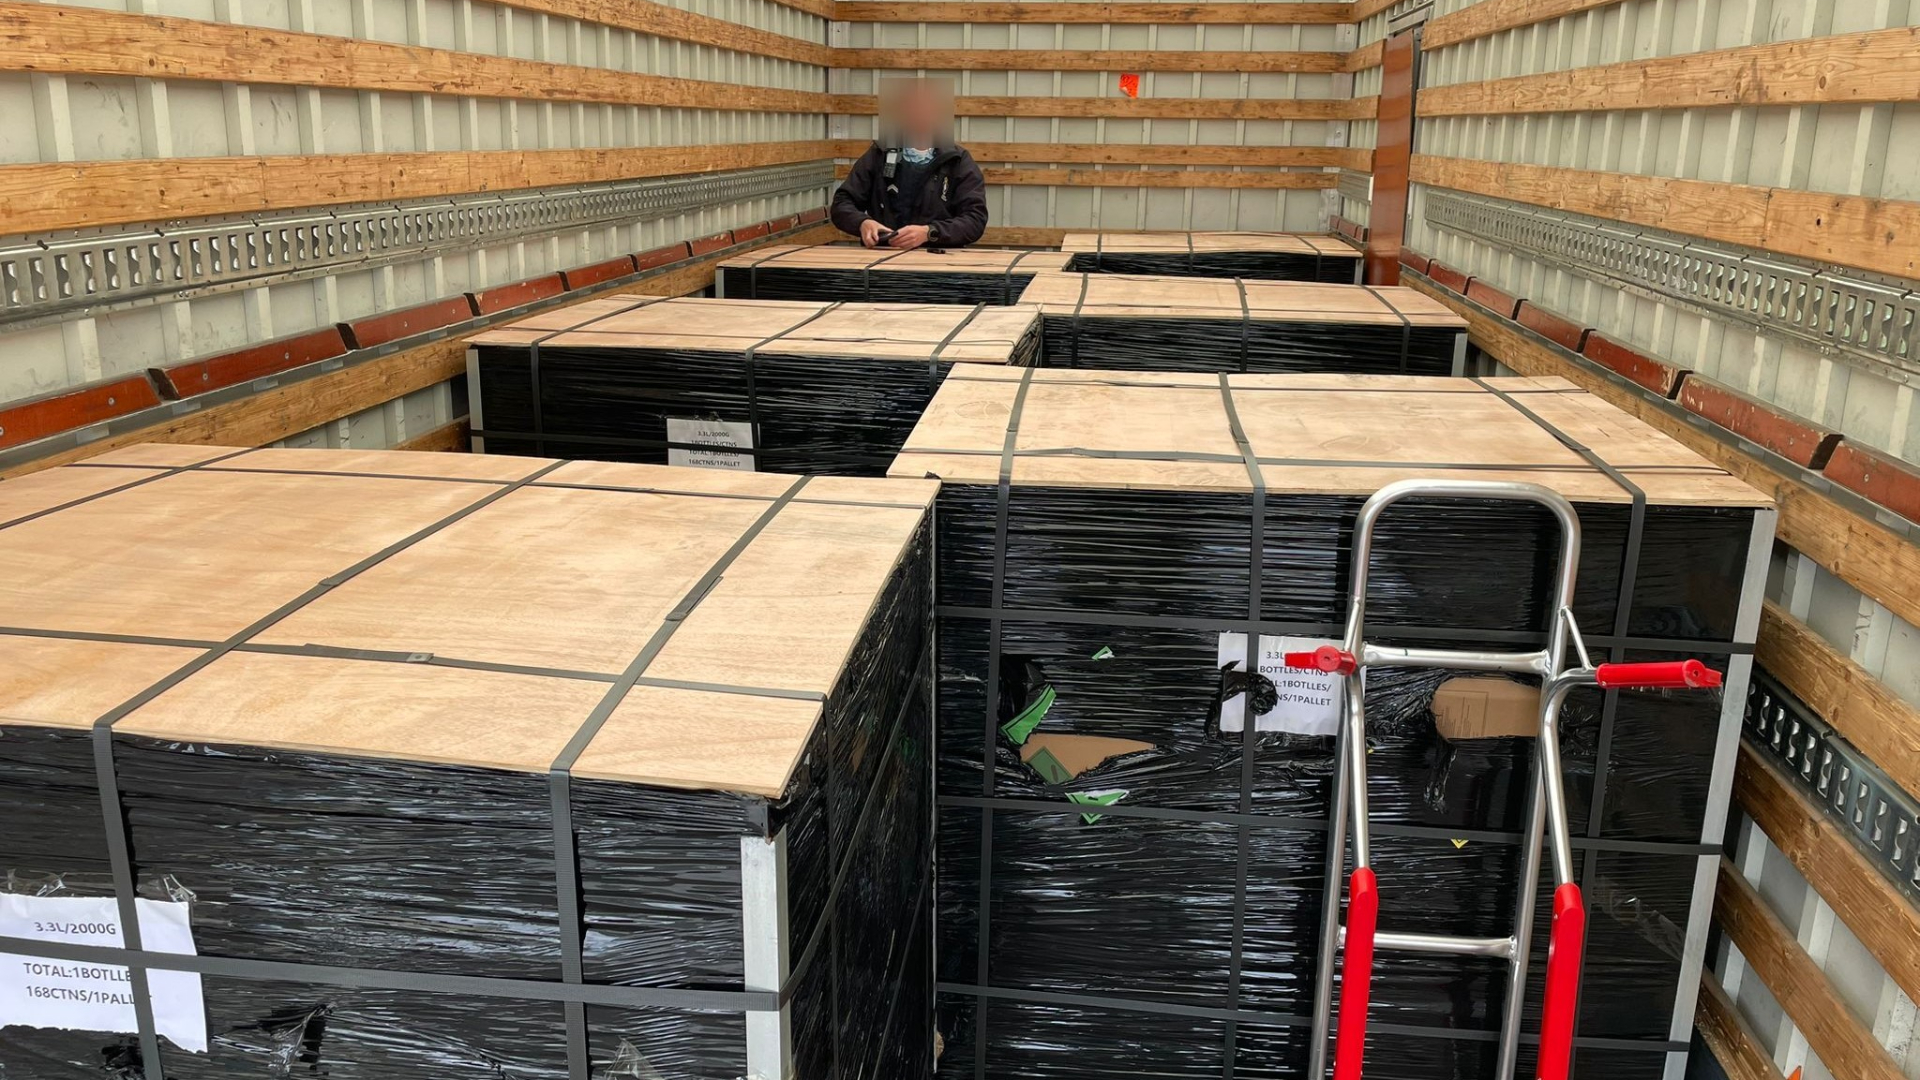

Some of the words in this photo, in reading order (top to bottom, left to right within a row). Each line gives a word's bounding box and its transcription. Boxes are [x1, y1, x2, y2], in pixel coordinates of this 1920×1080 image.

[1274, 680, 1332, 692] L:1BOTLLES/
[1276, 693, 1332, 706] NS/1PALLET
[34, 921, 117, 935] 3.3L/2000G
[23, 962, 131, 982] TOTAL:1BOTLLE
[26, 985, 152, 1005] 168CTNS/1PALL
